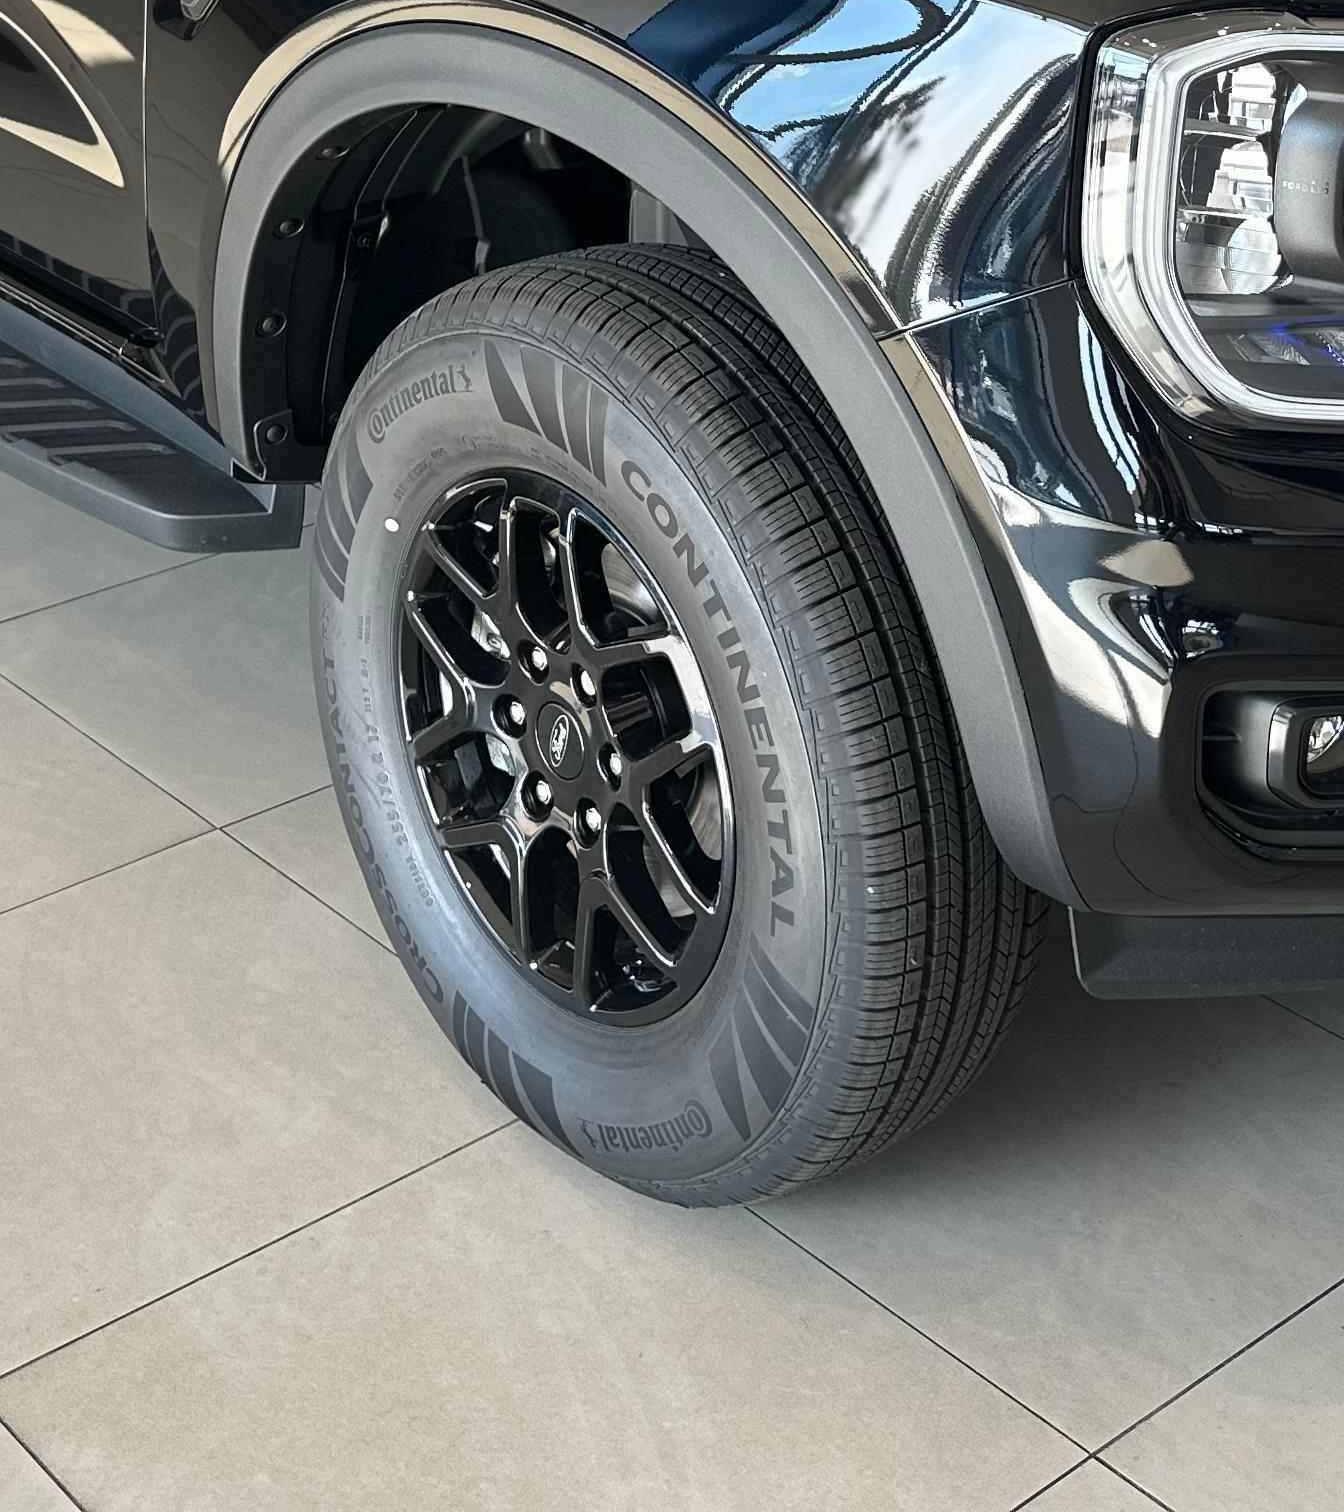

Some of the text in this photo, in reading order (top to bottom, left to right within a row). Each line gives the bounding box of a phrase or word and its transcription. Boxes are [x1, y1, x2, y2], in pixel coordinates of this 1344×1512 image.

[366, 363, 456, 444] Continental
[620, 459, 796, 938] CONTINENTAL
[597, 1098, 713, 1153] Continental
